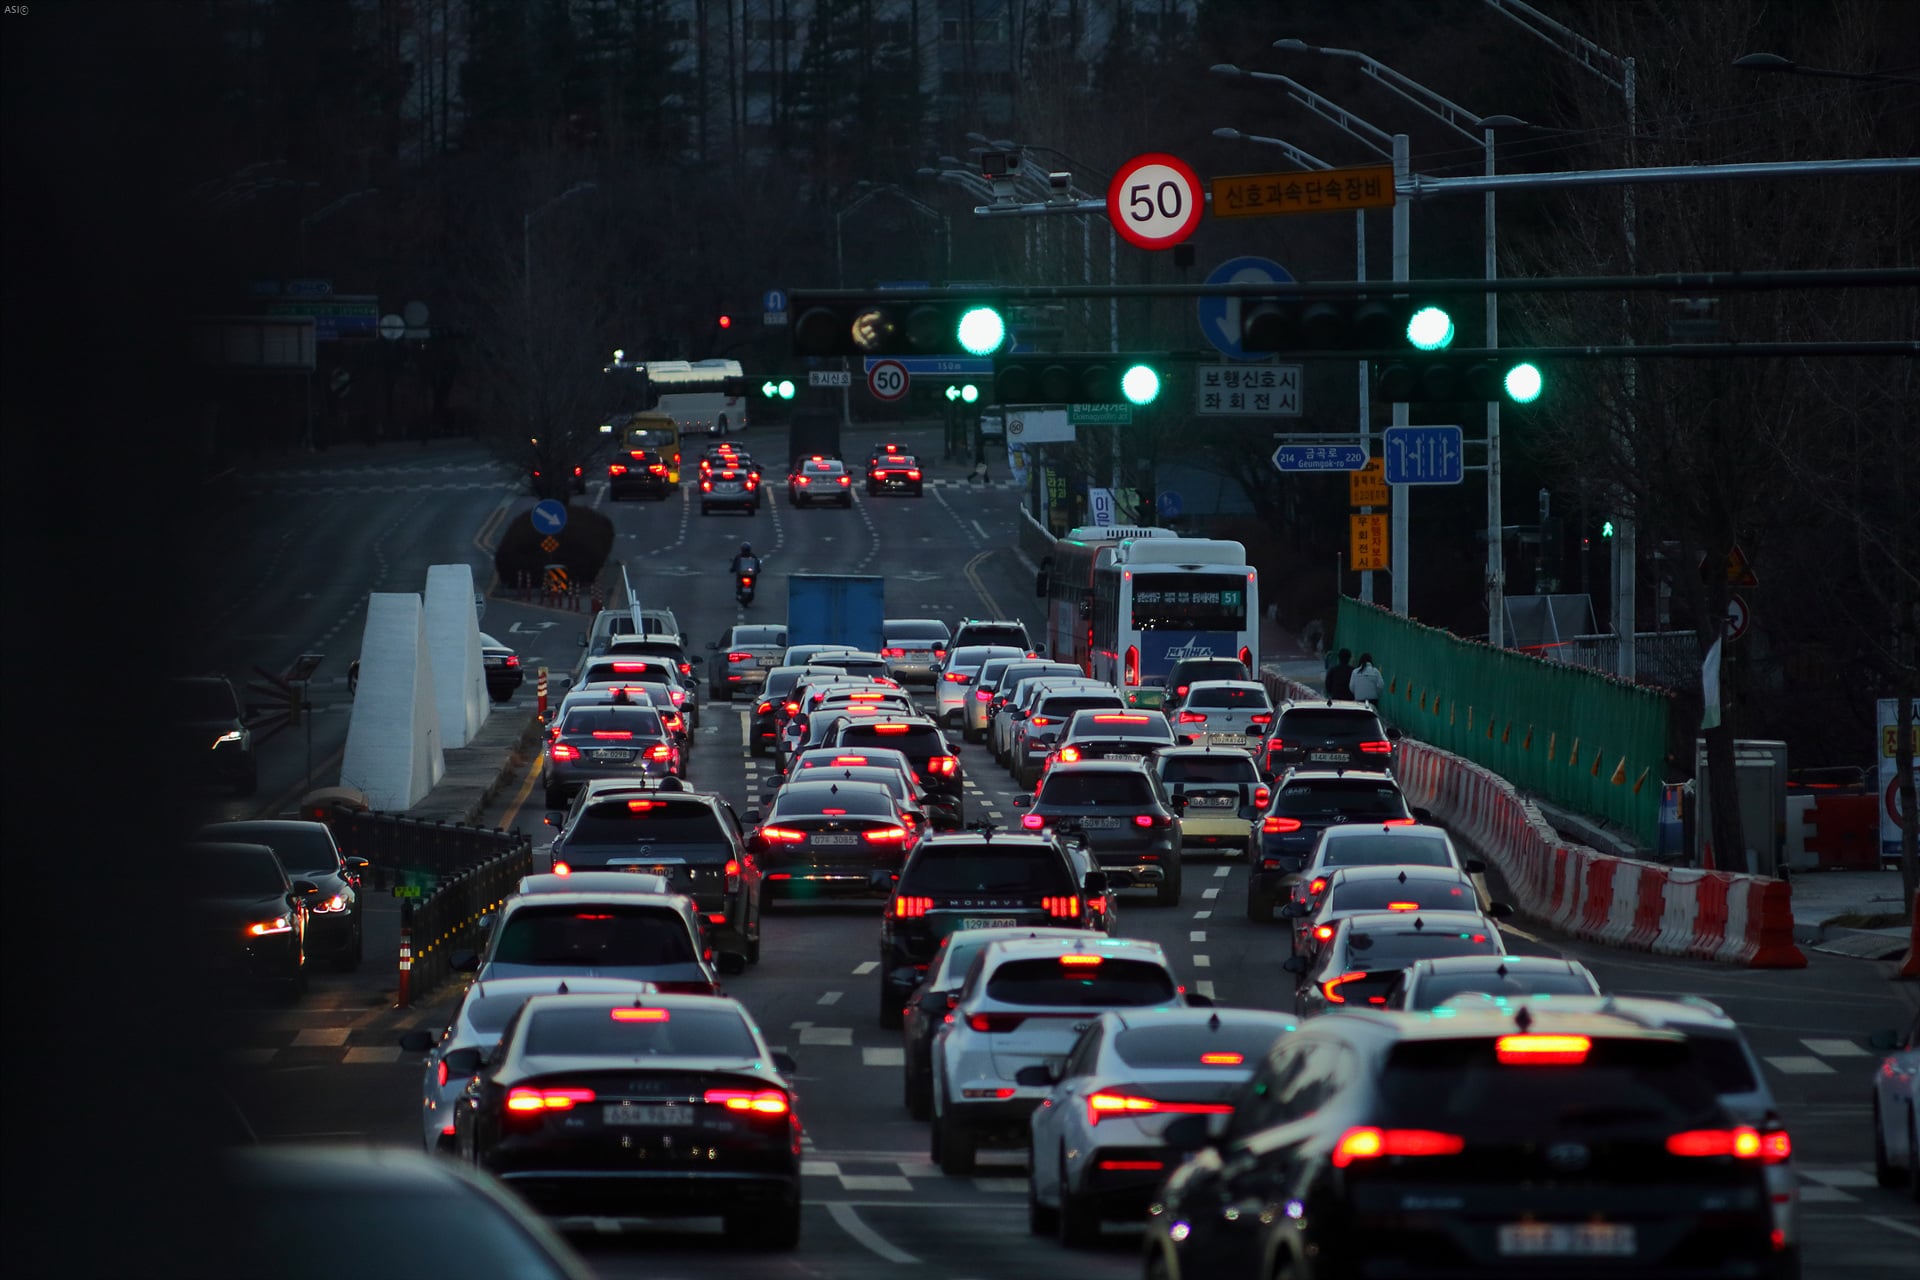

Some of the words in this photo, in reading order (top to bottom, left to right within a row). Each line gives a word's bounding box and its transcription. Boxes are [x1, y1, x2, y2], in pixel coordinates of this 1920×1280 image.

[1225, 175, 1382, 209] 신호과속단속장비
[1130, 181, 1182, 222] 50
[812, 373, 849, 385] 동시신호
[877, 372, 901, 390] 50
[1204, 370, 1296, 390] 보행신호시
[1280, 453, 1295, 463] 214
[1305, 447, 1338, 460] 금곡로
[1345, 453, 1362, 462] 220
[1298, 459, 1345, 469] Geumgok-ro
[1224, 592, 1237, 604] 51
